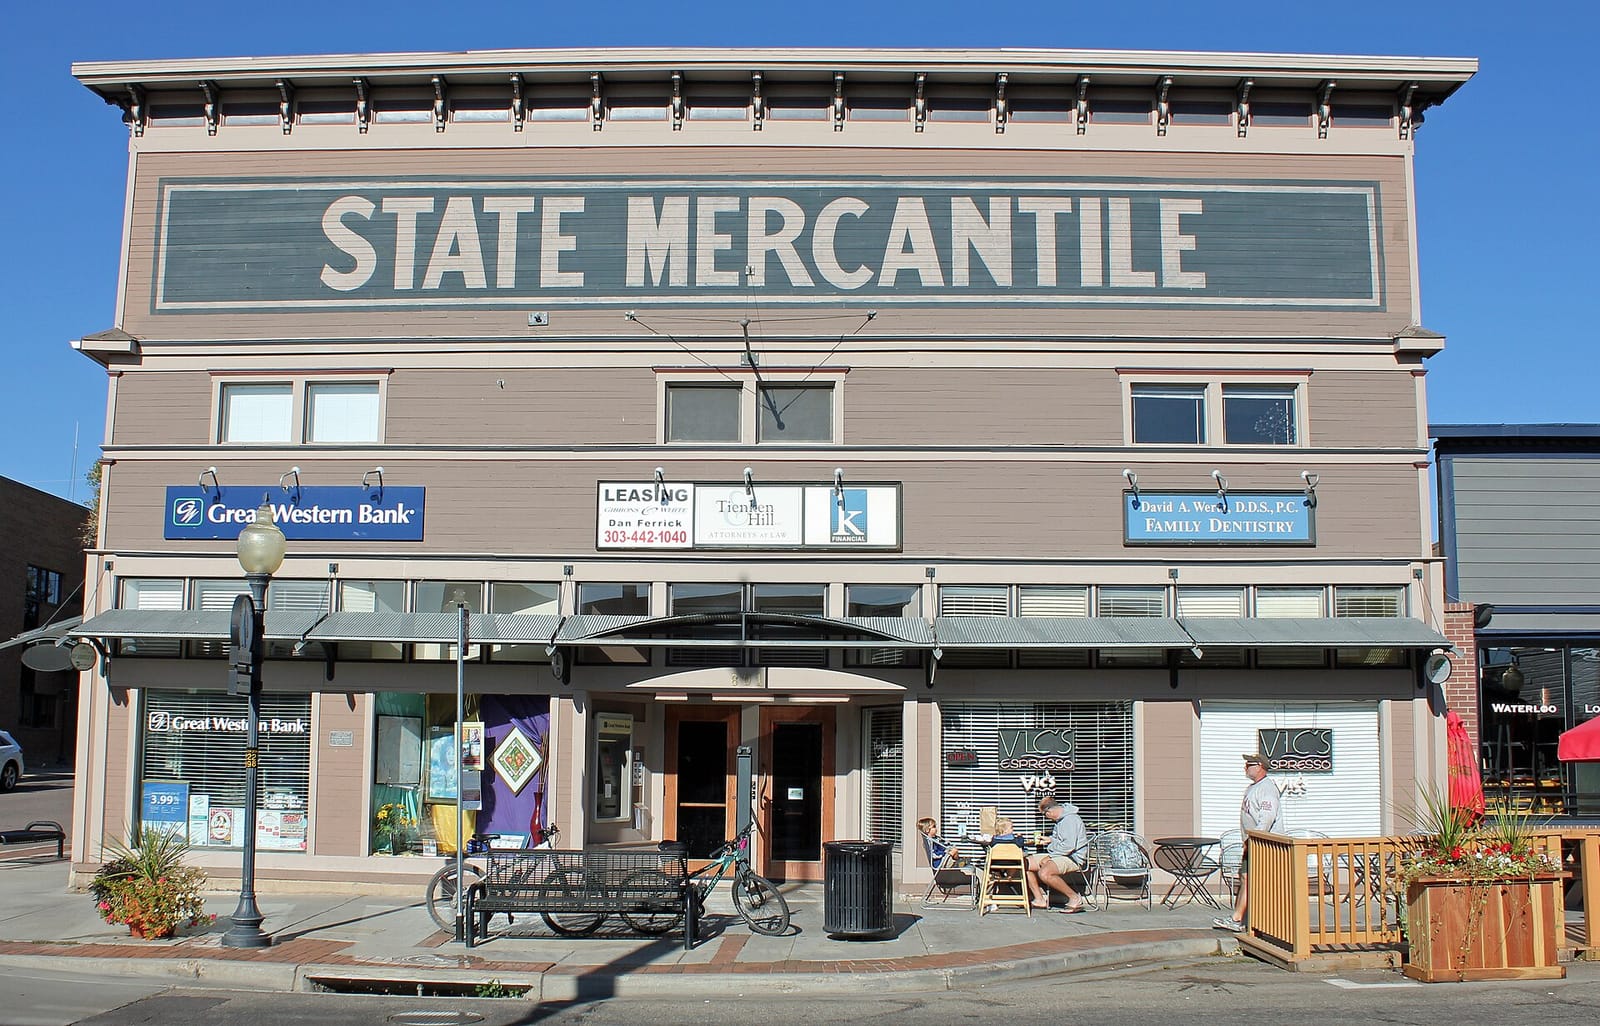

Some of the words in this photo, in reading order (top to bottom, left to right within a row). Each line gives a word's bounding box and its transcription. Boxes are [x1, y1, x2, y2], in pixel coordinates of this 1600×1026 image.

[320, 195, 585, 291] STATE
[625, 195, 1206, 290] MERCANTILE
[605, 489, 688, 502] LEASING
[715, 499, 774, 513] Tienken
[1141, 501, 1173, 513] David
[1178, 502, 1191, 513] A.
[1235, 502, 1274, 515] D.D.S.,
[1276, 502, 1299, 513] P.C.
[207, 504, 257, 524] Grea
[270, 504, 352, 523] Western
[358, 503, 410, 524] Bank
[748, 512, 775, 526] Hill
[608, 519, 632, 527] Dan
[638, 519, 682, 527] Ferrick
[1145, 518, 1202, 533] FAMILY
[1209, 518, 1295, 533] DENTISTRY
[604, 530, 687, 543] 303-442-1040
[1491, 703, 1557, 713] WATERLOO
[172, 717, 210, 730] Great
[213, 718, 267, 731] Westn
[271, 719, 305, 732] Bank
[947, 751, 975, 762] OPEN
[1000, 758, 1074, 769] ESPRESSO
[1268, 759, 1332, 770] SPRESSO
